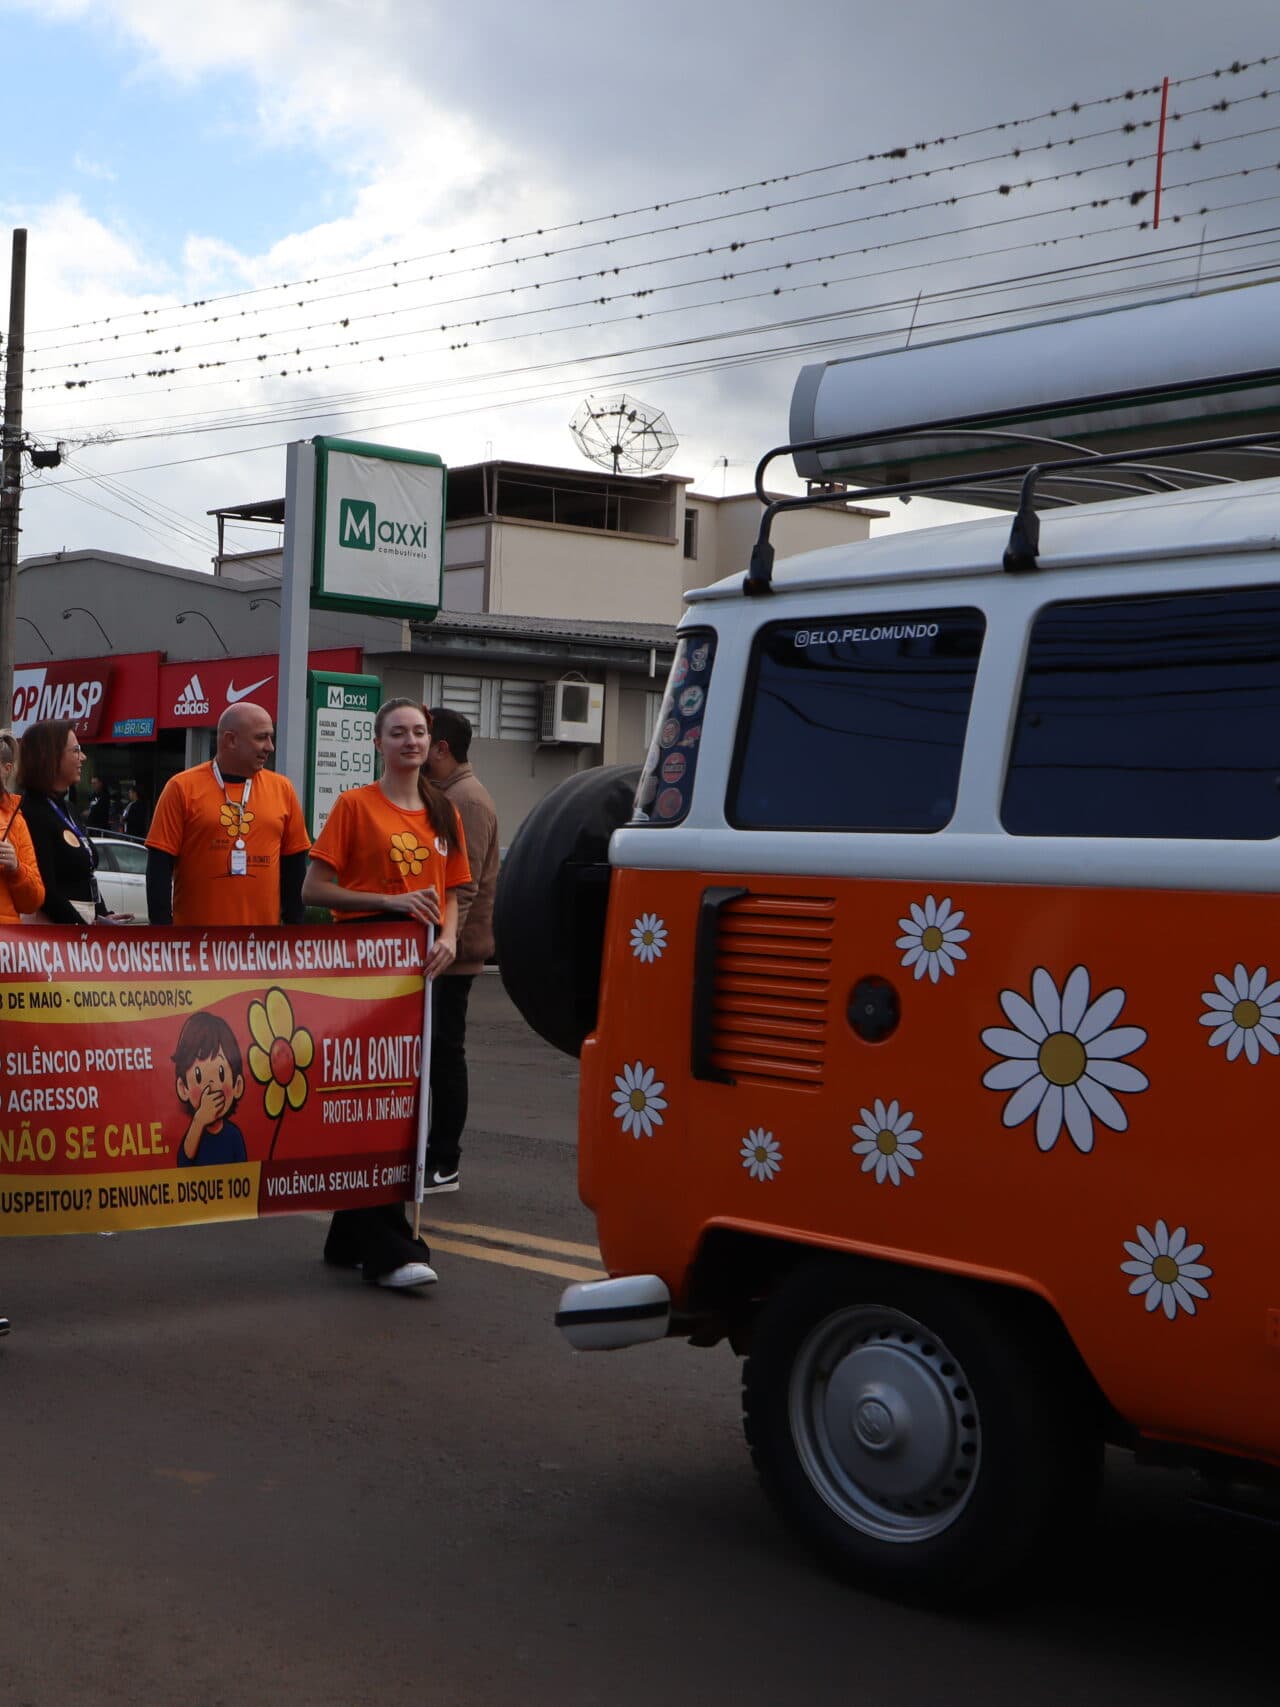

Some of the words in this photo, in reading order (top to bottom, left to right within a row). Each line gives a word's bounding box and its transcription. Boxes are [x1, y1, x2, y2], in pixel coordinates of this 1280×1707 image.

[344, 505, 428, 549] Maxxi
[174, 700, 209, 716] adidas
[330, 689, 368, 706] Maxxi
[341, 719, 373, 741] 6.59
[340, 750, 371, 773] 6.59
[66, 933, 104, 973] NÃO
[107, 941, 196, 973] CONSENTE.
[199, 933, 209, 972] É
[212, 933, 293, 971] VIOLÊNCIA
[295, 939, 355, 970] SEXUAL.
[356, 938, 424, 968] PROTEJA.
[8, 992, 25, 1010] DE
[30, 992, 62, 1008] MAIO
[74, 991, 117, 1008] CMDCA
[119, 989, 193, 1012] CAÇADOR/SC
[6, 1045, 81, 1075] SILÊNCIO
[85, 1047, 154, 1071] PROTEGE
[368, 1035, 422, 1080] BONITO
[8, 1086, 99, 1113] AGRESSOR
[323, 1098, 363, 1124] PROTEJA
[366, 1098, 373, 1120] A
[65, 1126, 97, 1160] SE
[104, 1122, 170, 1157] CALE.
[98, 1183, 174, 1209] DENUNCIE.
[178, 1179, 223, 1204] DISQUE
[228, 1177, 250, 1198] 100
[267, 1170, 325, 1196] VIOLÊNCIA
[329, 1171, 370, 1191] SEXUAL
[372, 1164, 378, 1187] É
[381, 1165, 411, 1186] CRIME!
